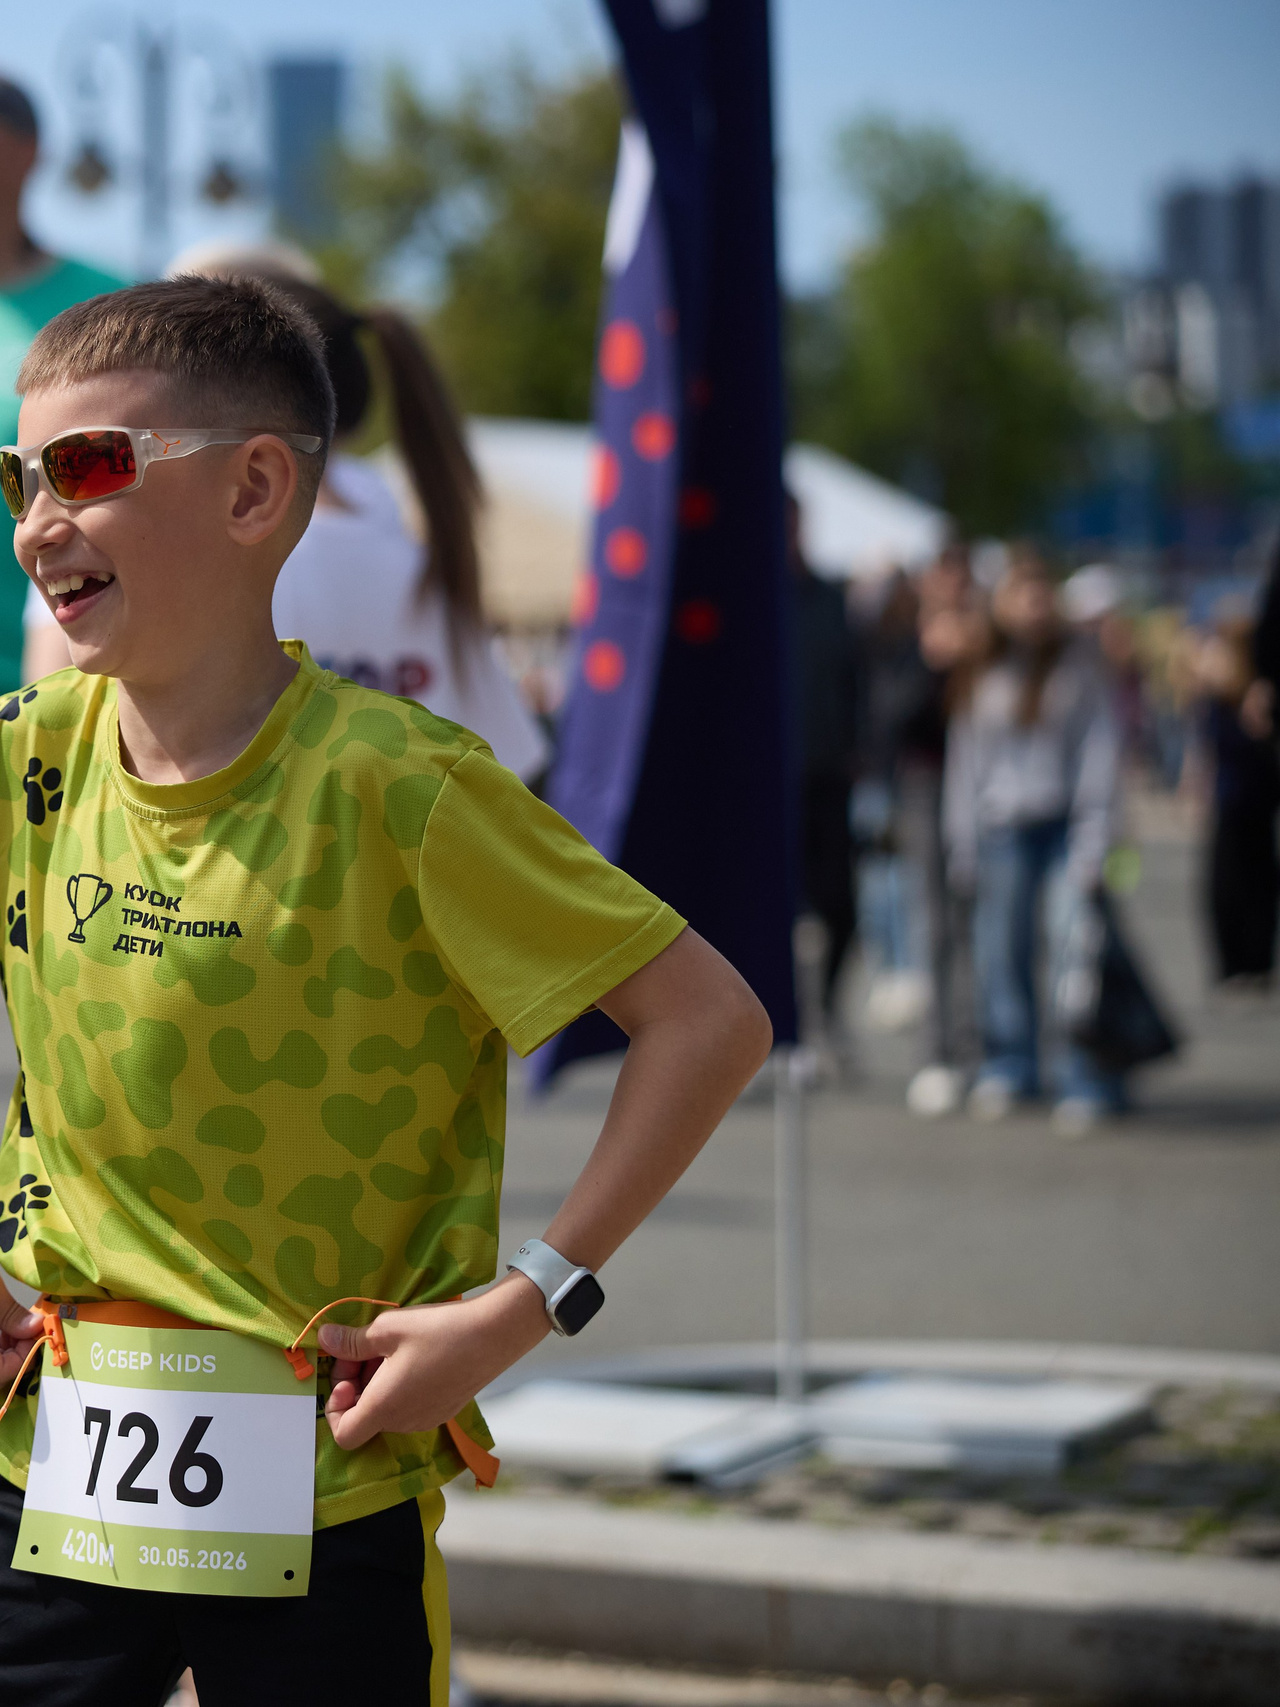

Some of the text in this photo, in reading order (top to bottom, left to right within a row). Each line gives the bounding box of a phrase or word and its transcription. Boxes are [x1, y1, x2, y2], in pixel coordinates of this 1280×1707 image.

[124, 883, 182, 912] КУОК
[112, 933, 164, 957] ДЕТИ
[106, 1348, 217, 1374] СБЕР KIDS
[83, 1405, 224, 1508] 726
[138, 1545, 248, 1571] 30.05.2026
